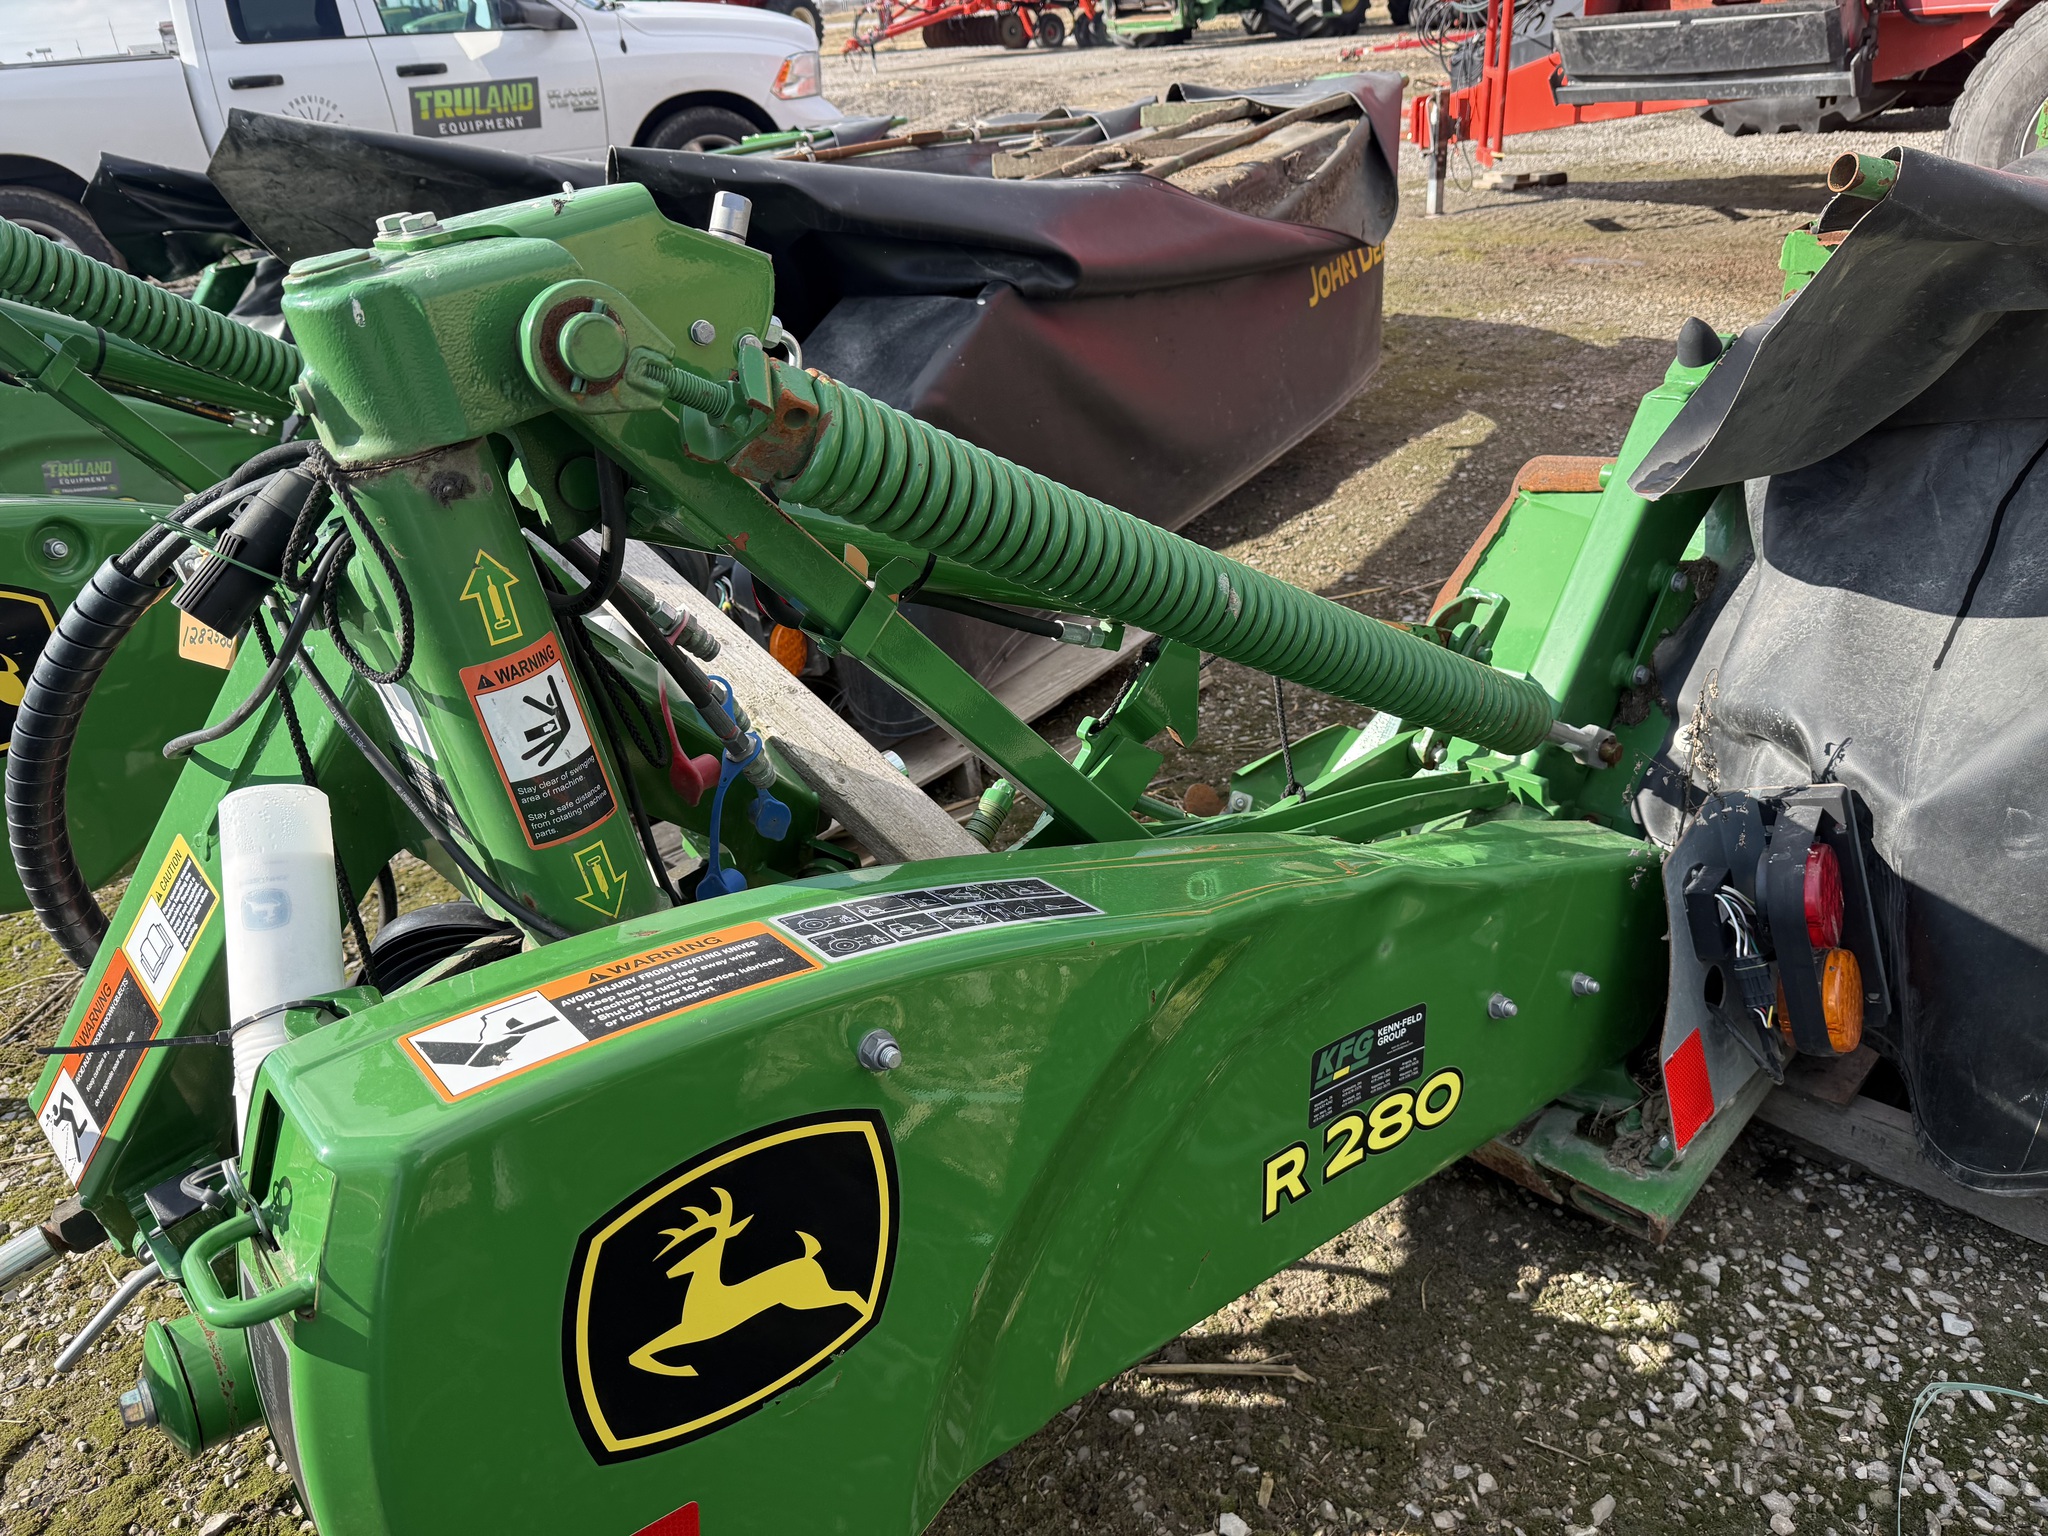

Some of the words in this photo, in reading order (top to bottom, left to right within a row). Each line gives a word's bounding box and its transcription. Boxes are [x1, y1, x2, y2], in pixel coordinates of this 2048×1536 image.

[288, 95, 338, 111] PROVIDER
[415, 83, 534, 120] TRULAND
[439, 116, 524, 135] EQUIPMENT
[1309, 251, 1358, 308] JOHN
[48, 461, 112, 478] TRULAND
[59, 476, 106, 485] EQUIPMENT
[494, 644, 555, 684] WARNING
[518, 784, 537, 796] Stay
[539, 777, 559, 789] clear
[560, 771, 569, 782] of
[570, 755, 595, 778] swinging
[522, 793, 540, 804] area
[543, 787, 552, 799] of
[552, 776, 586, 795] machine.
[528, 809, 548, 822] Stay
[549, 808, 555, 816] a
[557, 800, 574, 814] safe
[575, 784, 601, 804] distance
[531, 819, 551, 830] from
[552, 808, 582, 825] rotating
[583, 789, 607, 811] machine
[535, 826, 558, 839] parts.
[160, 850, 182, 891] CAUTION
[561, 990, 596, 1008] AVOID
[597, 977, 638, 995] INJURY
[639, 966, 671, 982] FROM
[671, 950, 722, 971] ROTATING
[723, 940, 759, 955] KNIVES
[607, 936, 723, 975] WARNING
[585, 994, 616, 1010] Keep
[620, 981, 653, 1000] hands
[655, 974, 675, 989] and
[676, 967, 699, 981] feet
[700, 957, 729, 976] away
[728, 949, 757, 964] while
[592, 996, 638, 1016] machine
[640, 990, 653, 1001] is
[655, 976, 698, 997] running
[597, 1008, 627, 1023] Shut
[628, 1001, 645, 1015] off
[647, 987, 682, 1008] power
[682, 984, 695, 996] to
[697, 970, 739, 989] service,
[738, 956, 785, 975] lubricate
[79, 982, 112, 1044] WARNING
[605, 1018, 618, 1028] or
[620, 1008, 645, 1023] fold
[647, 1003, 662, 1016] for
[663, 985, 716, 1008] transport
[75, 1065, 85, 1084] AVOID
[82, 1052, 93, 1067] INJUR
[93, 1027, 104, 1046] FROM
[101, 1004, 116, 1031] THROWN
[112, 978, 128, 1005] OBJECTS
[1316, 1029, 1375, 1080] KFG
[1377, 1012, 1422, 1037] KENN-FELD
[1377, 1028, 1407, 1046] GROUP
[86, 1077, 95, 1092] Keep
[93, 1058, 105, 1078] curtains
[102, 1051, 108, 1059] in
[95, 1098, 100, 1107] do
[102, 1071, 114, 1091] operate
[112, 1059, 120, 1072] near
[1264, 1144, 1309, 1219] R
[1325, 1069, 1462, 1182] 280
